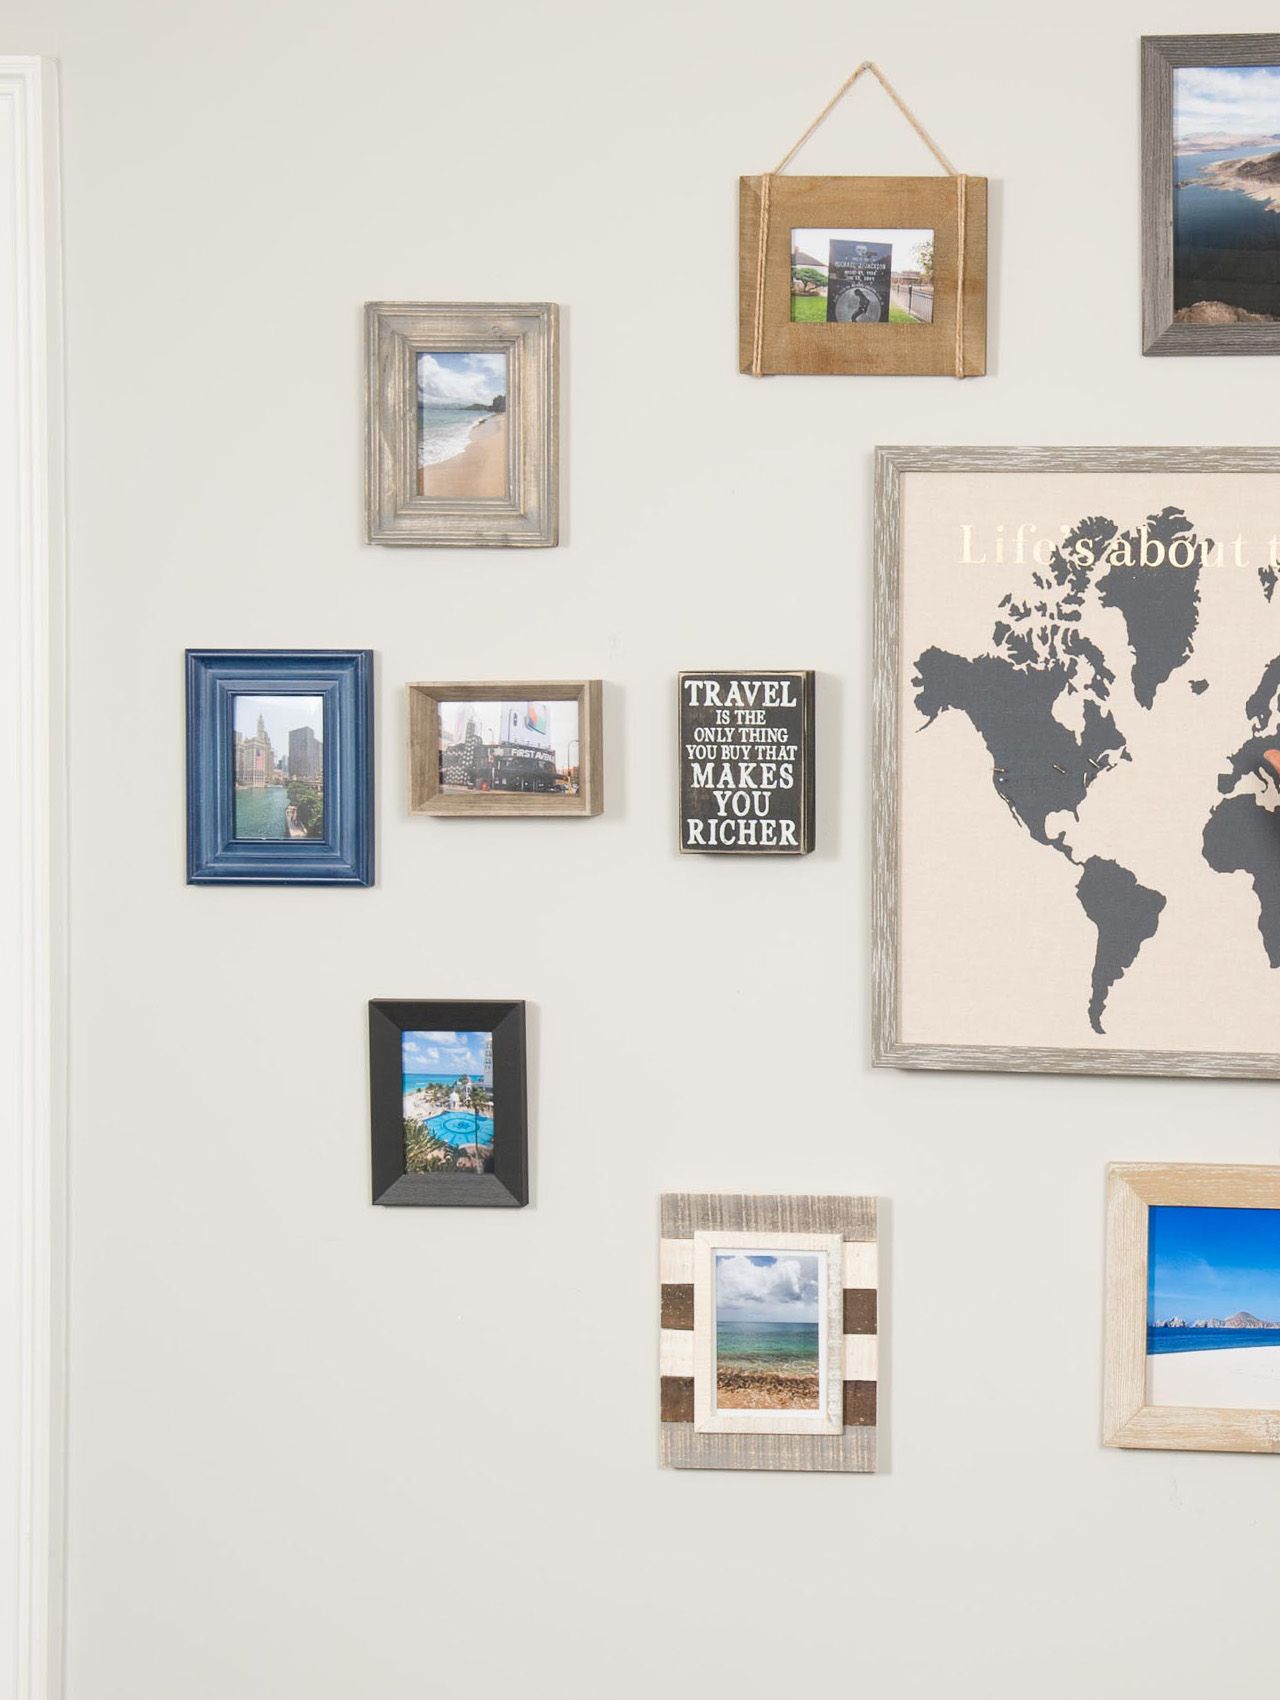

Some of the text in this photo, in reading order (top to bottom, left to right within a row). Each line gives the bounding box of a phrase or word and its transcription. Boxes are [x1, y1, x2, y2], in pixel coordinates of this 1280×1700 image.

[957, 524, 1095, 567] Life's
[1109, 524, 1250, 568] about
[685, 680, 797, 708] TRAVEL
[716, 710, 767, 725] IS THE
[694, 727, 789, 743] ONLY THING
[512, 748, 536, 759] FIRST
[686, 745, 798, 761] YOU BUY THAT
[690, 762, 795, 789] MAKES
[713, 790, 772, 817] YOU
[687, 818, 799, 846] RICHER
